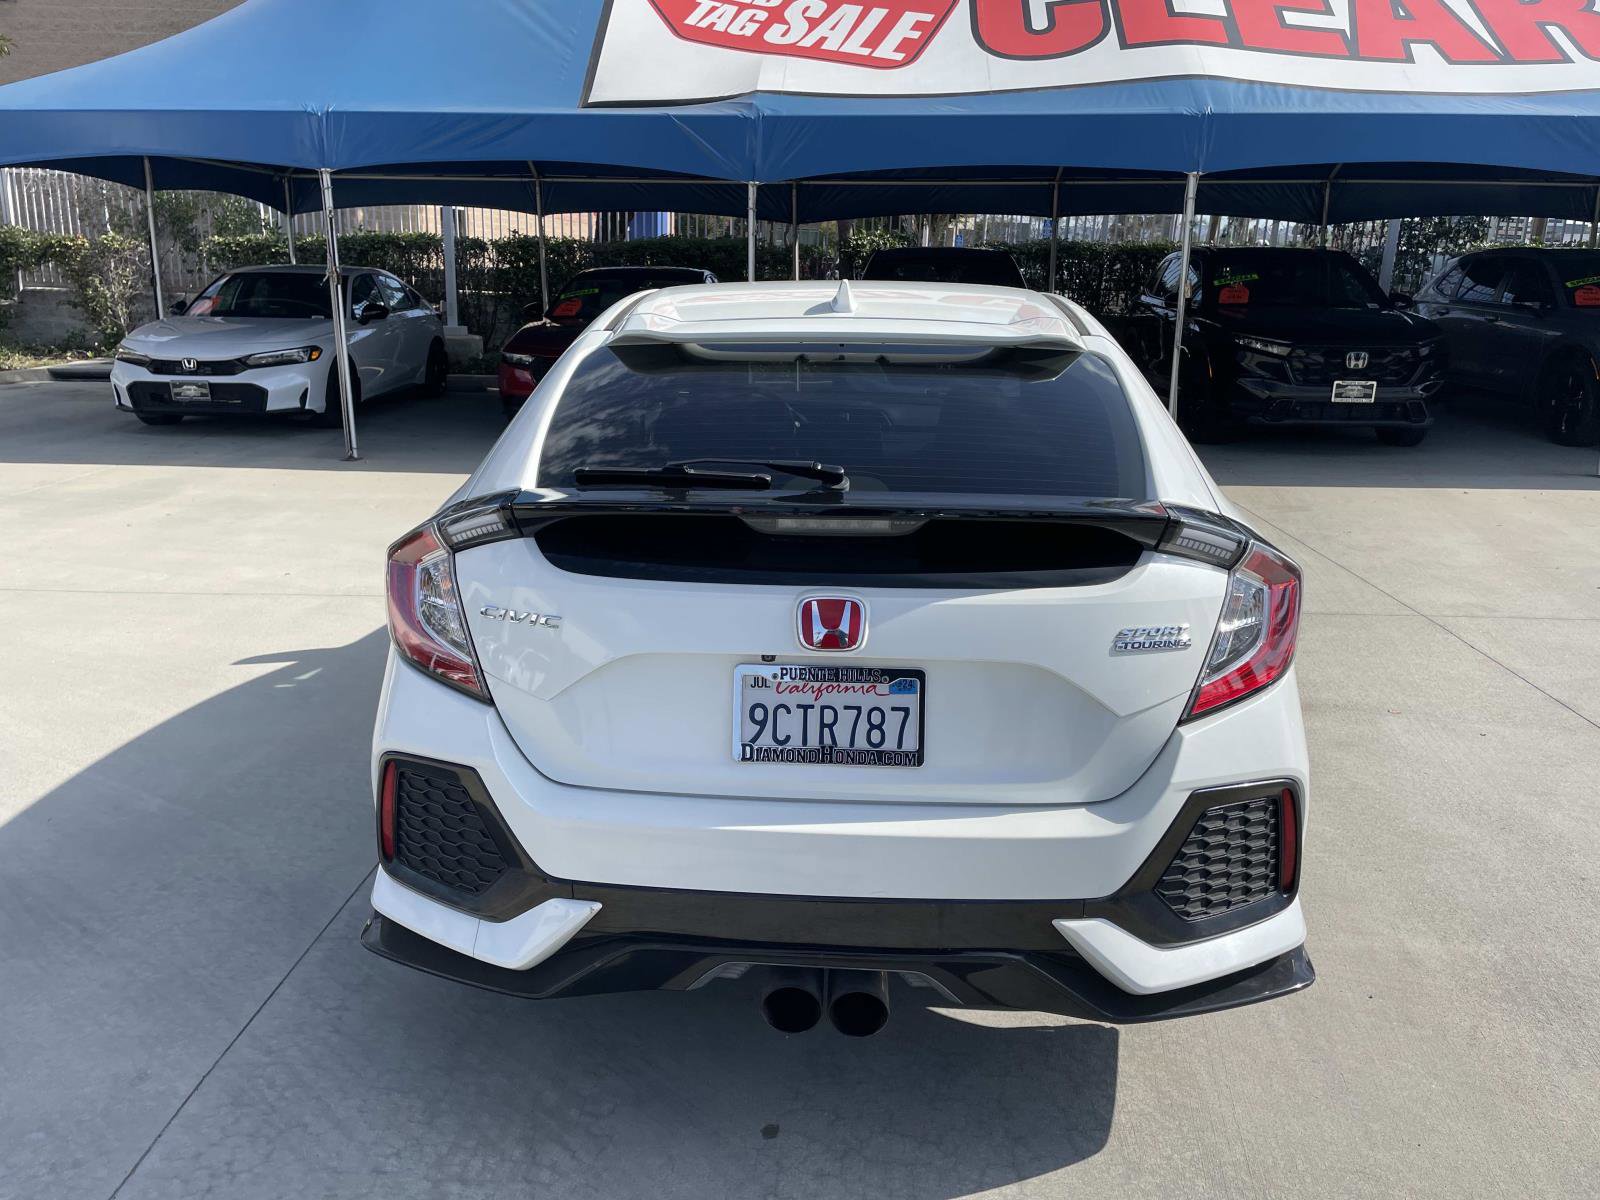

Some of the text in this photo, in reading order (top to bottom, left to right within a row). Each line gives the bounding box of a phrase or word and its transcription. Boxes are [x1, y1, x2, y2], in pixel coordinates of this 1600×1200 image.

[683, 1, 935, 61] TAG SALE
[480, 605, 562, 629] CIVIC
[1115, 624, 1189, 638] SPORT
[1117, 638, 1191, 650] TOURING
[750, 677, 771, 689] JUL
[780, 667, 882, 683] PUENTE HILLS
[776, 681, 890, 702] California
[748, 703, 911, 749] 9CTR787
